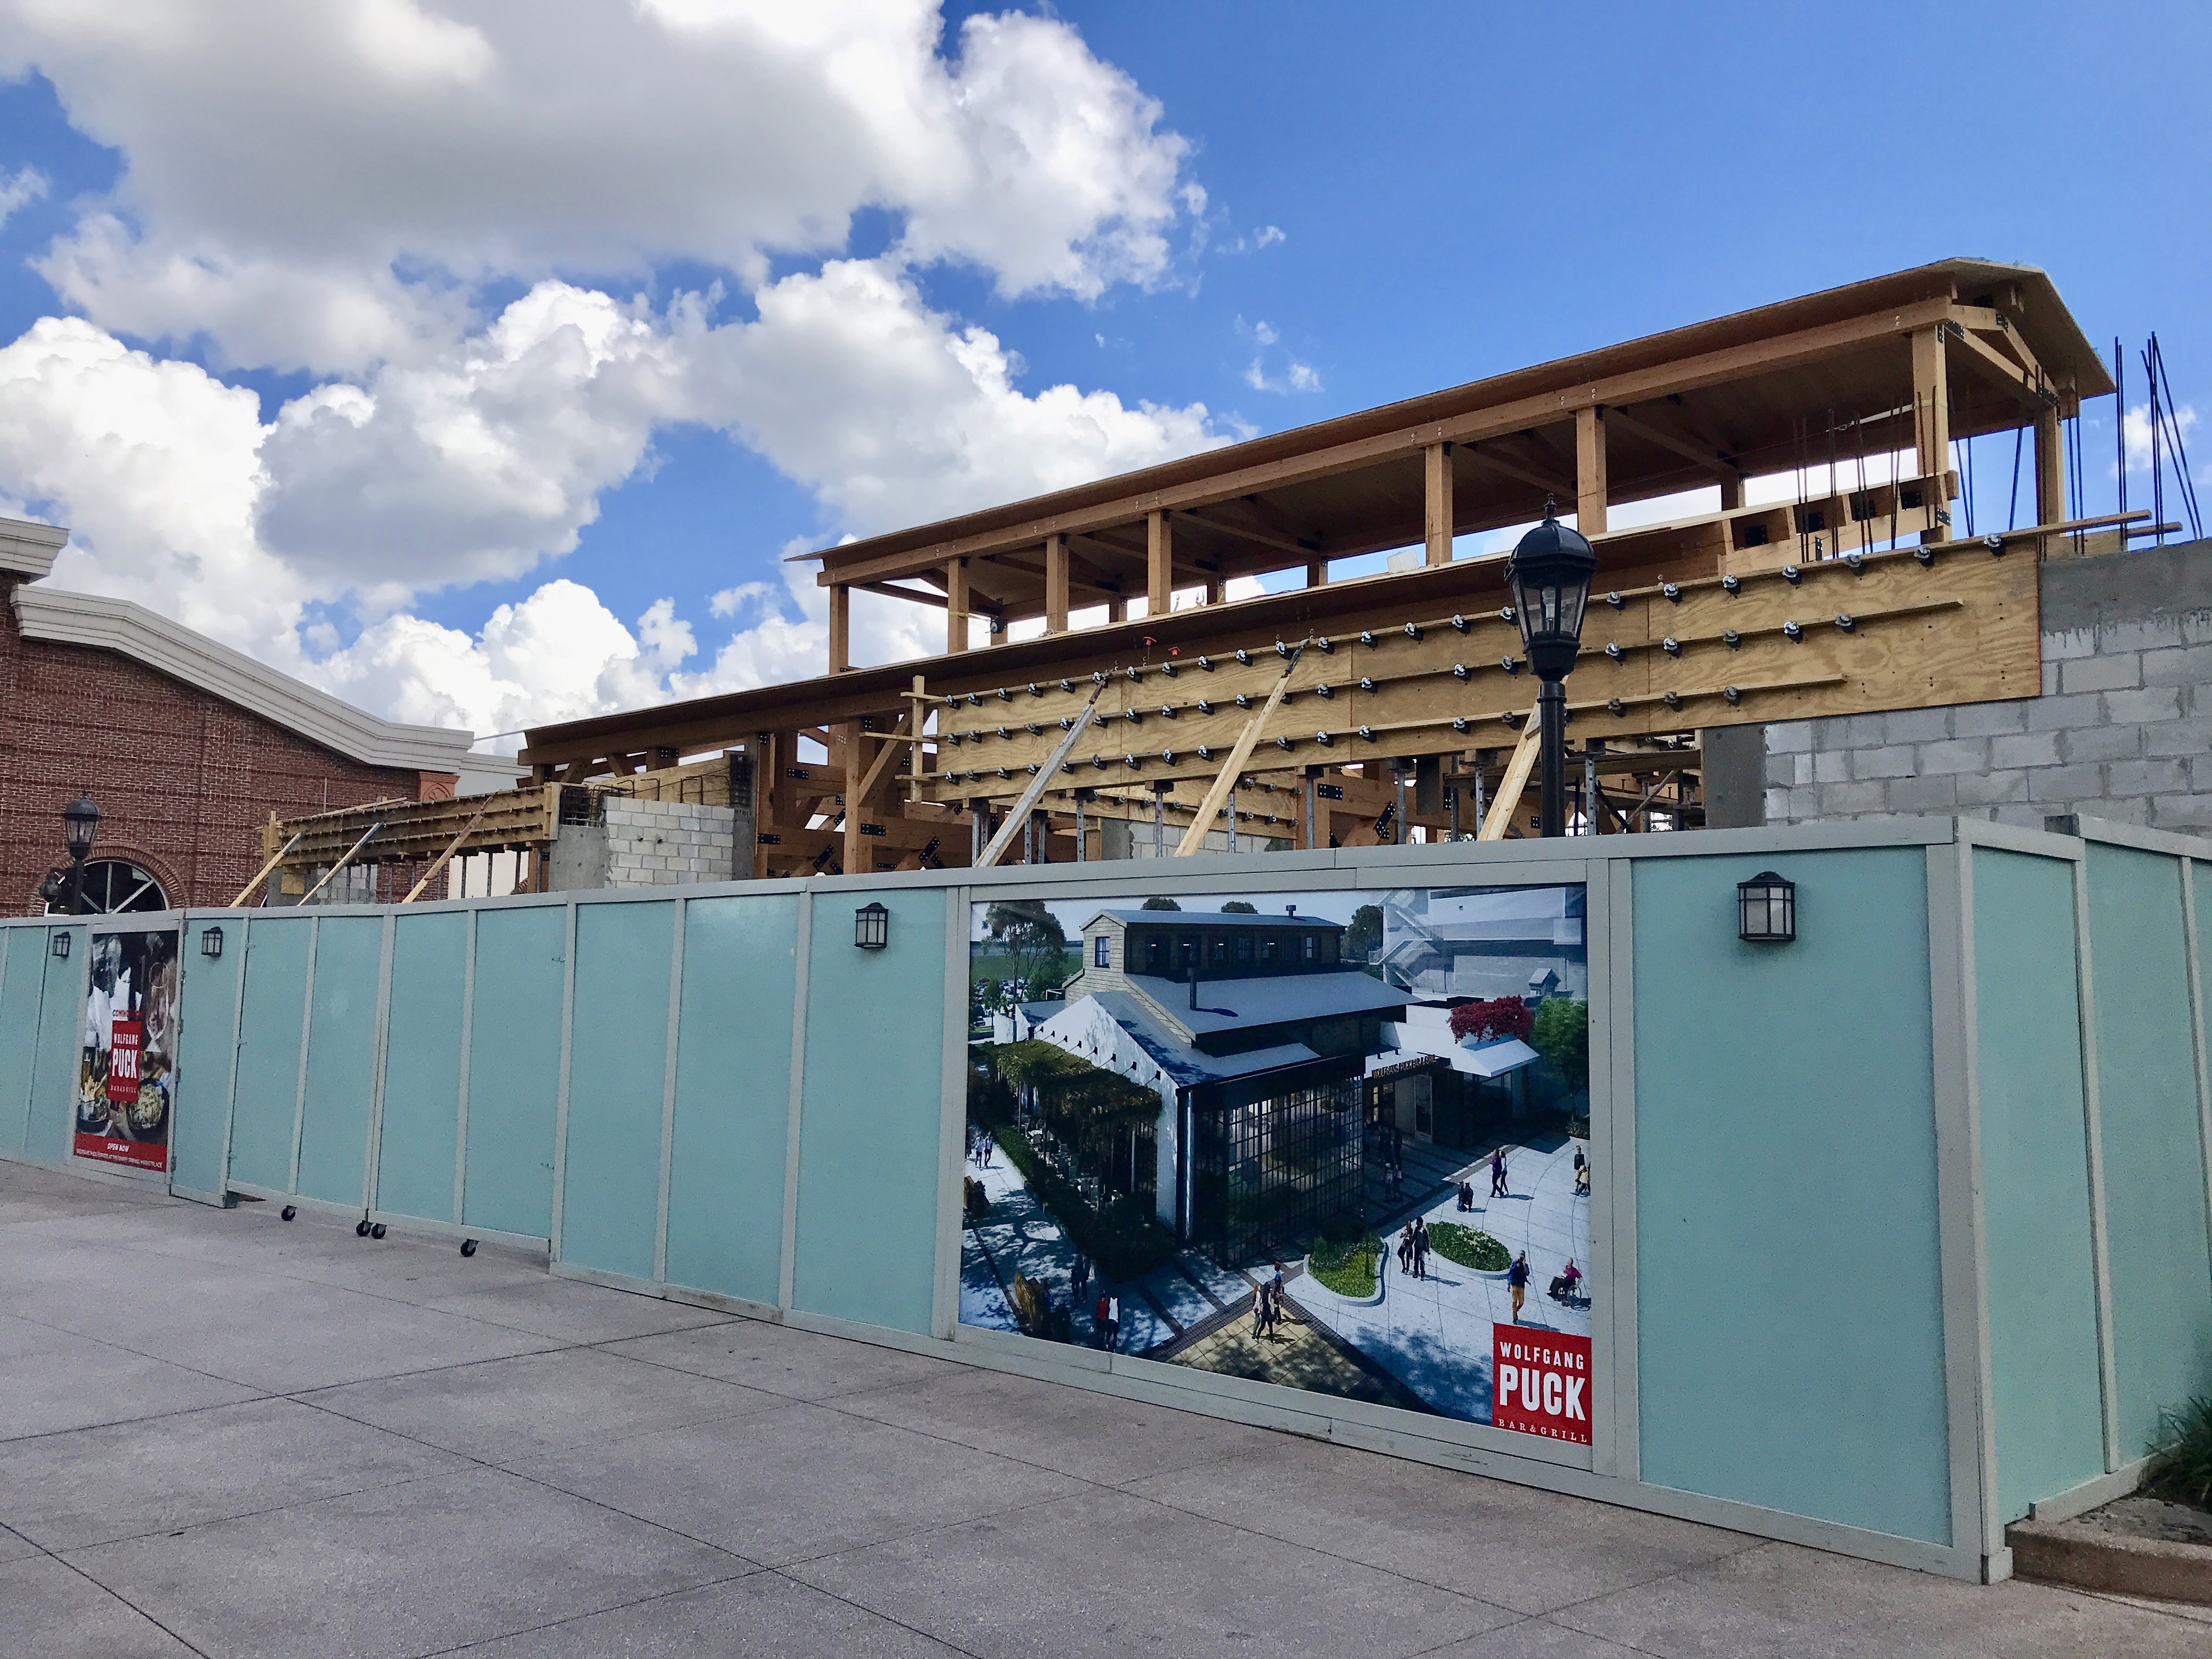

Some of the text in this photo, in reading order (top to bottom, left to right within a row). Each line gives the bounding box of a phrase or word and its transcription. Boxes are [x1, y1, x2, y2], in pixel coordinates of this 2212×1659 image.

[114, 1033, 138, 1045] WOLFGANG
[112, 1048, 138, 1079] PUCK
[1372, 1064, 1399, 1079] WOLFGANG
[119, 1144, 130, 1153] NOW
[1500, 1341, 1584, 1369] WOLFGANG
[1499, 1364, 1586, 1421] PUCK
